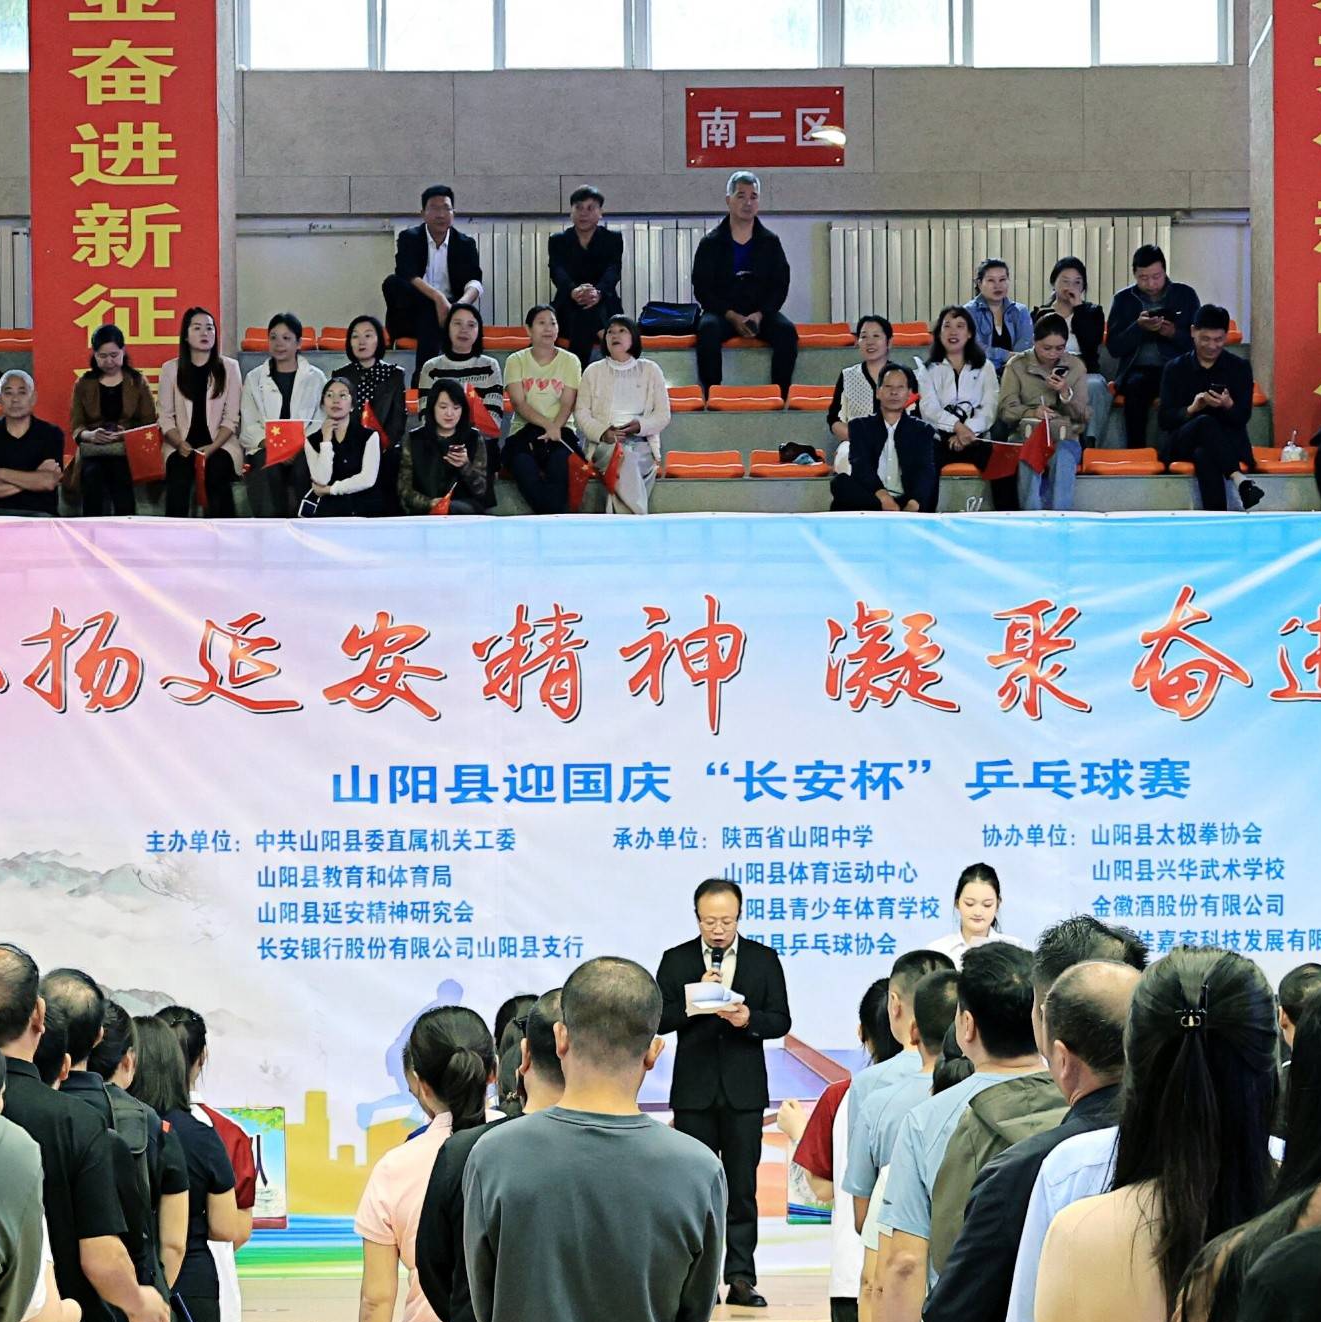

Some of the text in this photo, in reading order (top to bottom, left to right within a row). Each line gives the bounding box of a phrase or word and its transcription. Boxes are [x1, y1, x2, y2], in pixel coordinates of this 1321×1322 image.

[697, 106, 831, 149] 南二区
[67, 0, 182, 398] 奋进新征
[257, 865, 452, 888] 山阳县教育和体育局
[724, 861, 918, 885] 山阳县体育运动中心
[1092, 857, 1286, 882] 山阳县兴华武术学校
[257, 900, 475, 924] 山阳县延安精神研究会
[738, 896, 941, 921] 阳县青少年体育学校
[1091, 893, 1285, 918] 金徽酒股份有限公司
[257, 935, 584, 960] 长安银行股份有限公司山阳县支行
[746, 931, 897, 957] 县乒乓球协会
